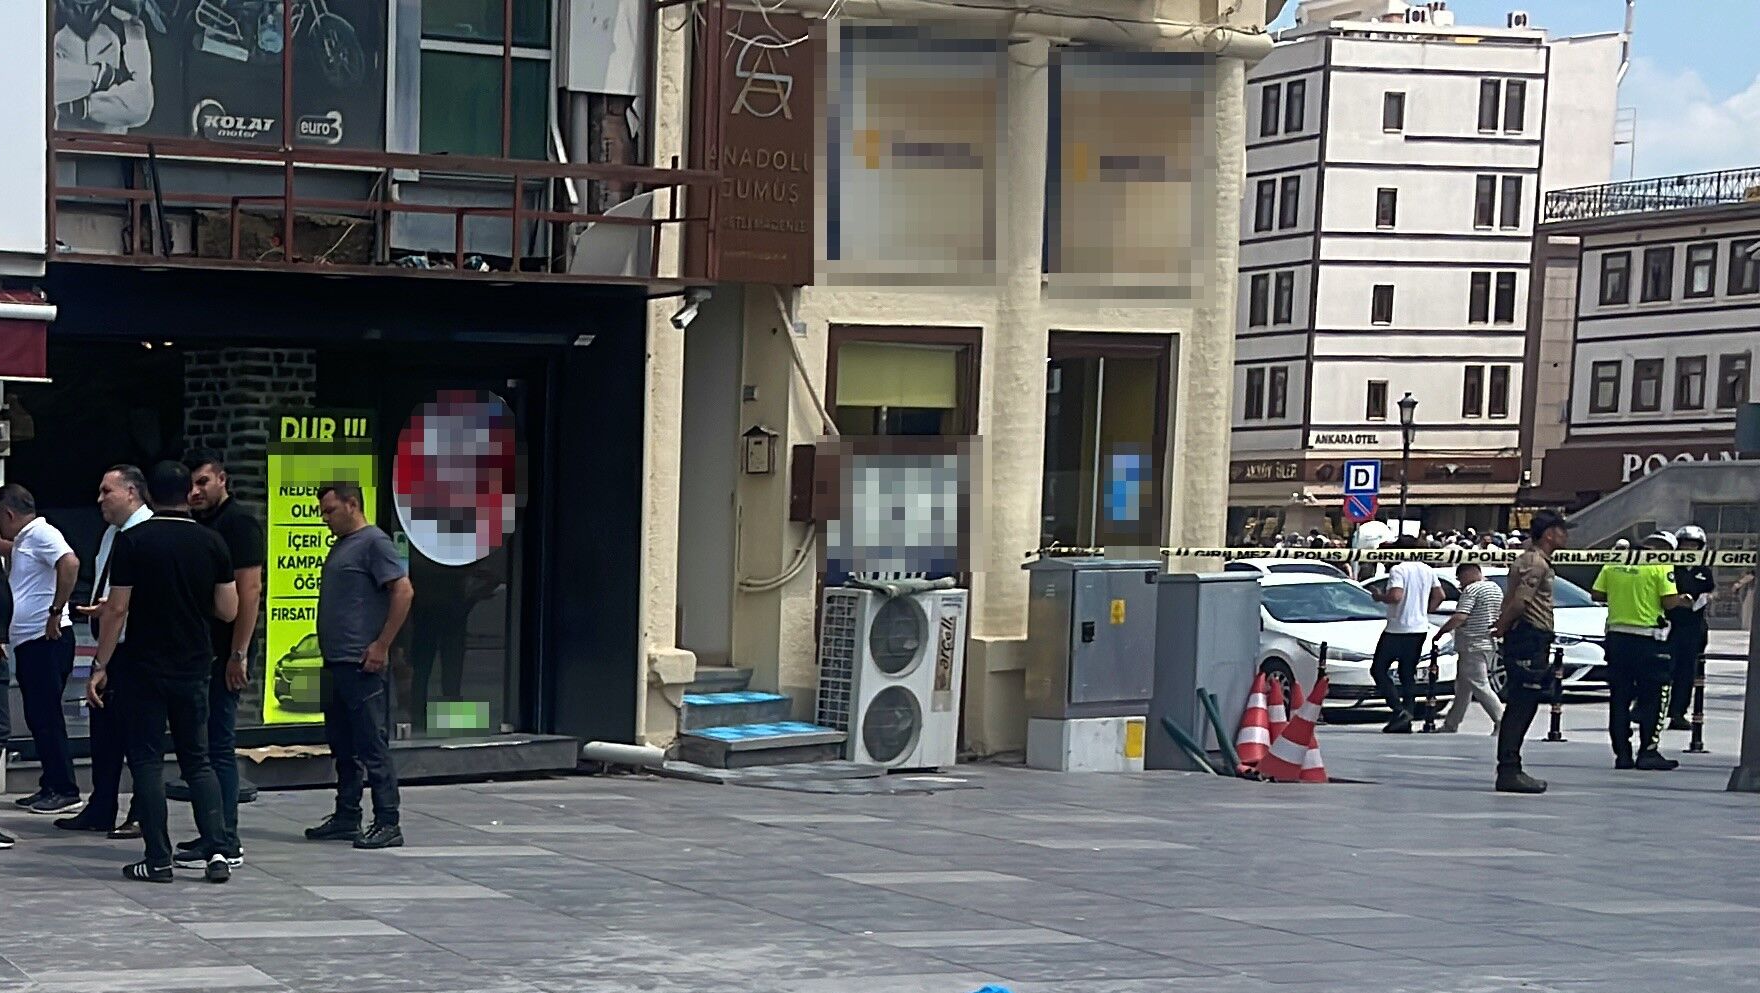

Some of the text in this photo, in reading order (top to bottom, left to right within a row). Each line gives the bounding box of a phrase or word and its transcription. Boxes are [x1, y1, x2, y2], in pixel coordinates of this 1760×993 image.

[203, 115, 275, 132] KOLAT
[1315, 434, 1378, 444] ANKARA OTEL
[1354, 468, 1370, 487] D
[288, 531, 321, 551] İÇERİ
[277, 556, 324, 569] KAMPA
[271, 607, 316, 621] FIRSATI
